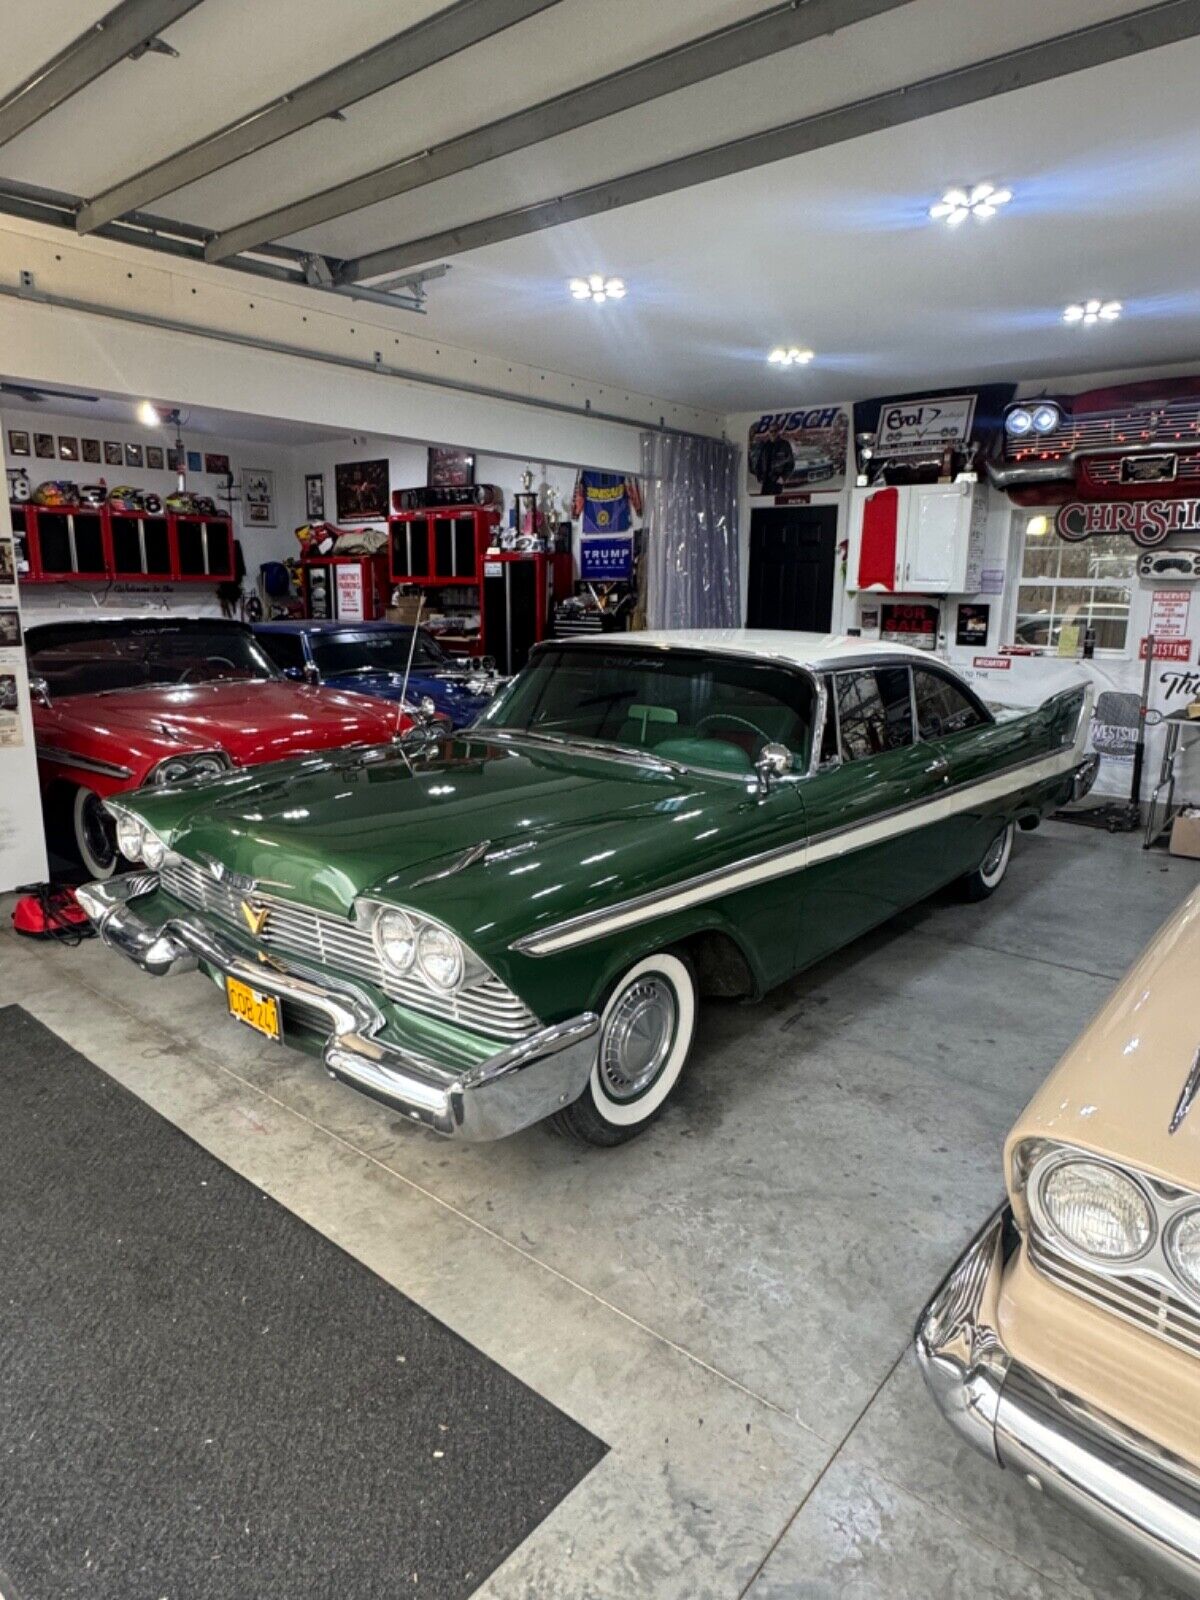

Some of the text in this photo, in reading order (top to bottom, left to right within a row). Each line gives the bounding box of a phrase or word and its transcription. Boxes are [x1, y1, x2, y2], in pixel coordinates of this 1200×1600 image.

[757, 408, 840, 434] BUSCH
[1060, 501, 1200, 545] CHRISTI
[584, 549, 630, 558] TRUMP
[1153, 592, 1188, 600] RESERVED
[892, 606, 926, 618] FOR
[886, 620, 934, 632] SALE
[1142, 644, 1188, 656] CRISTINE
